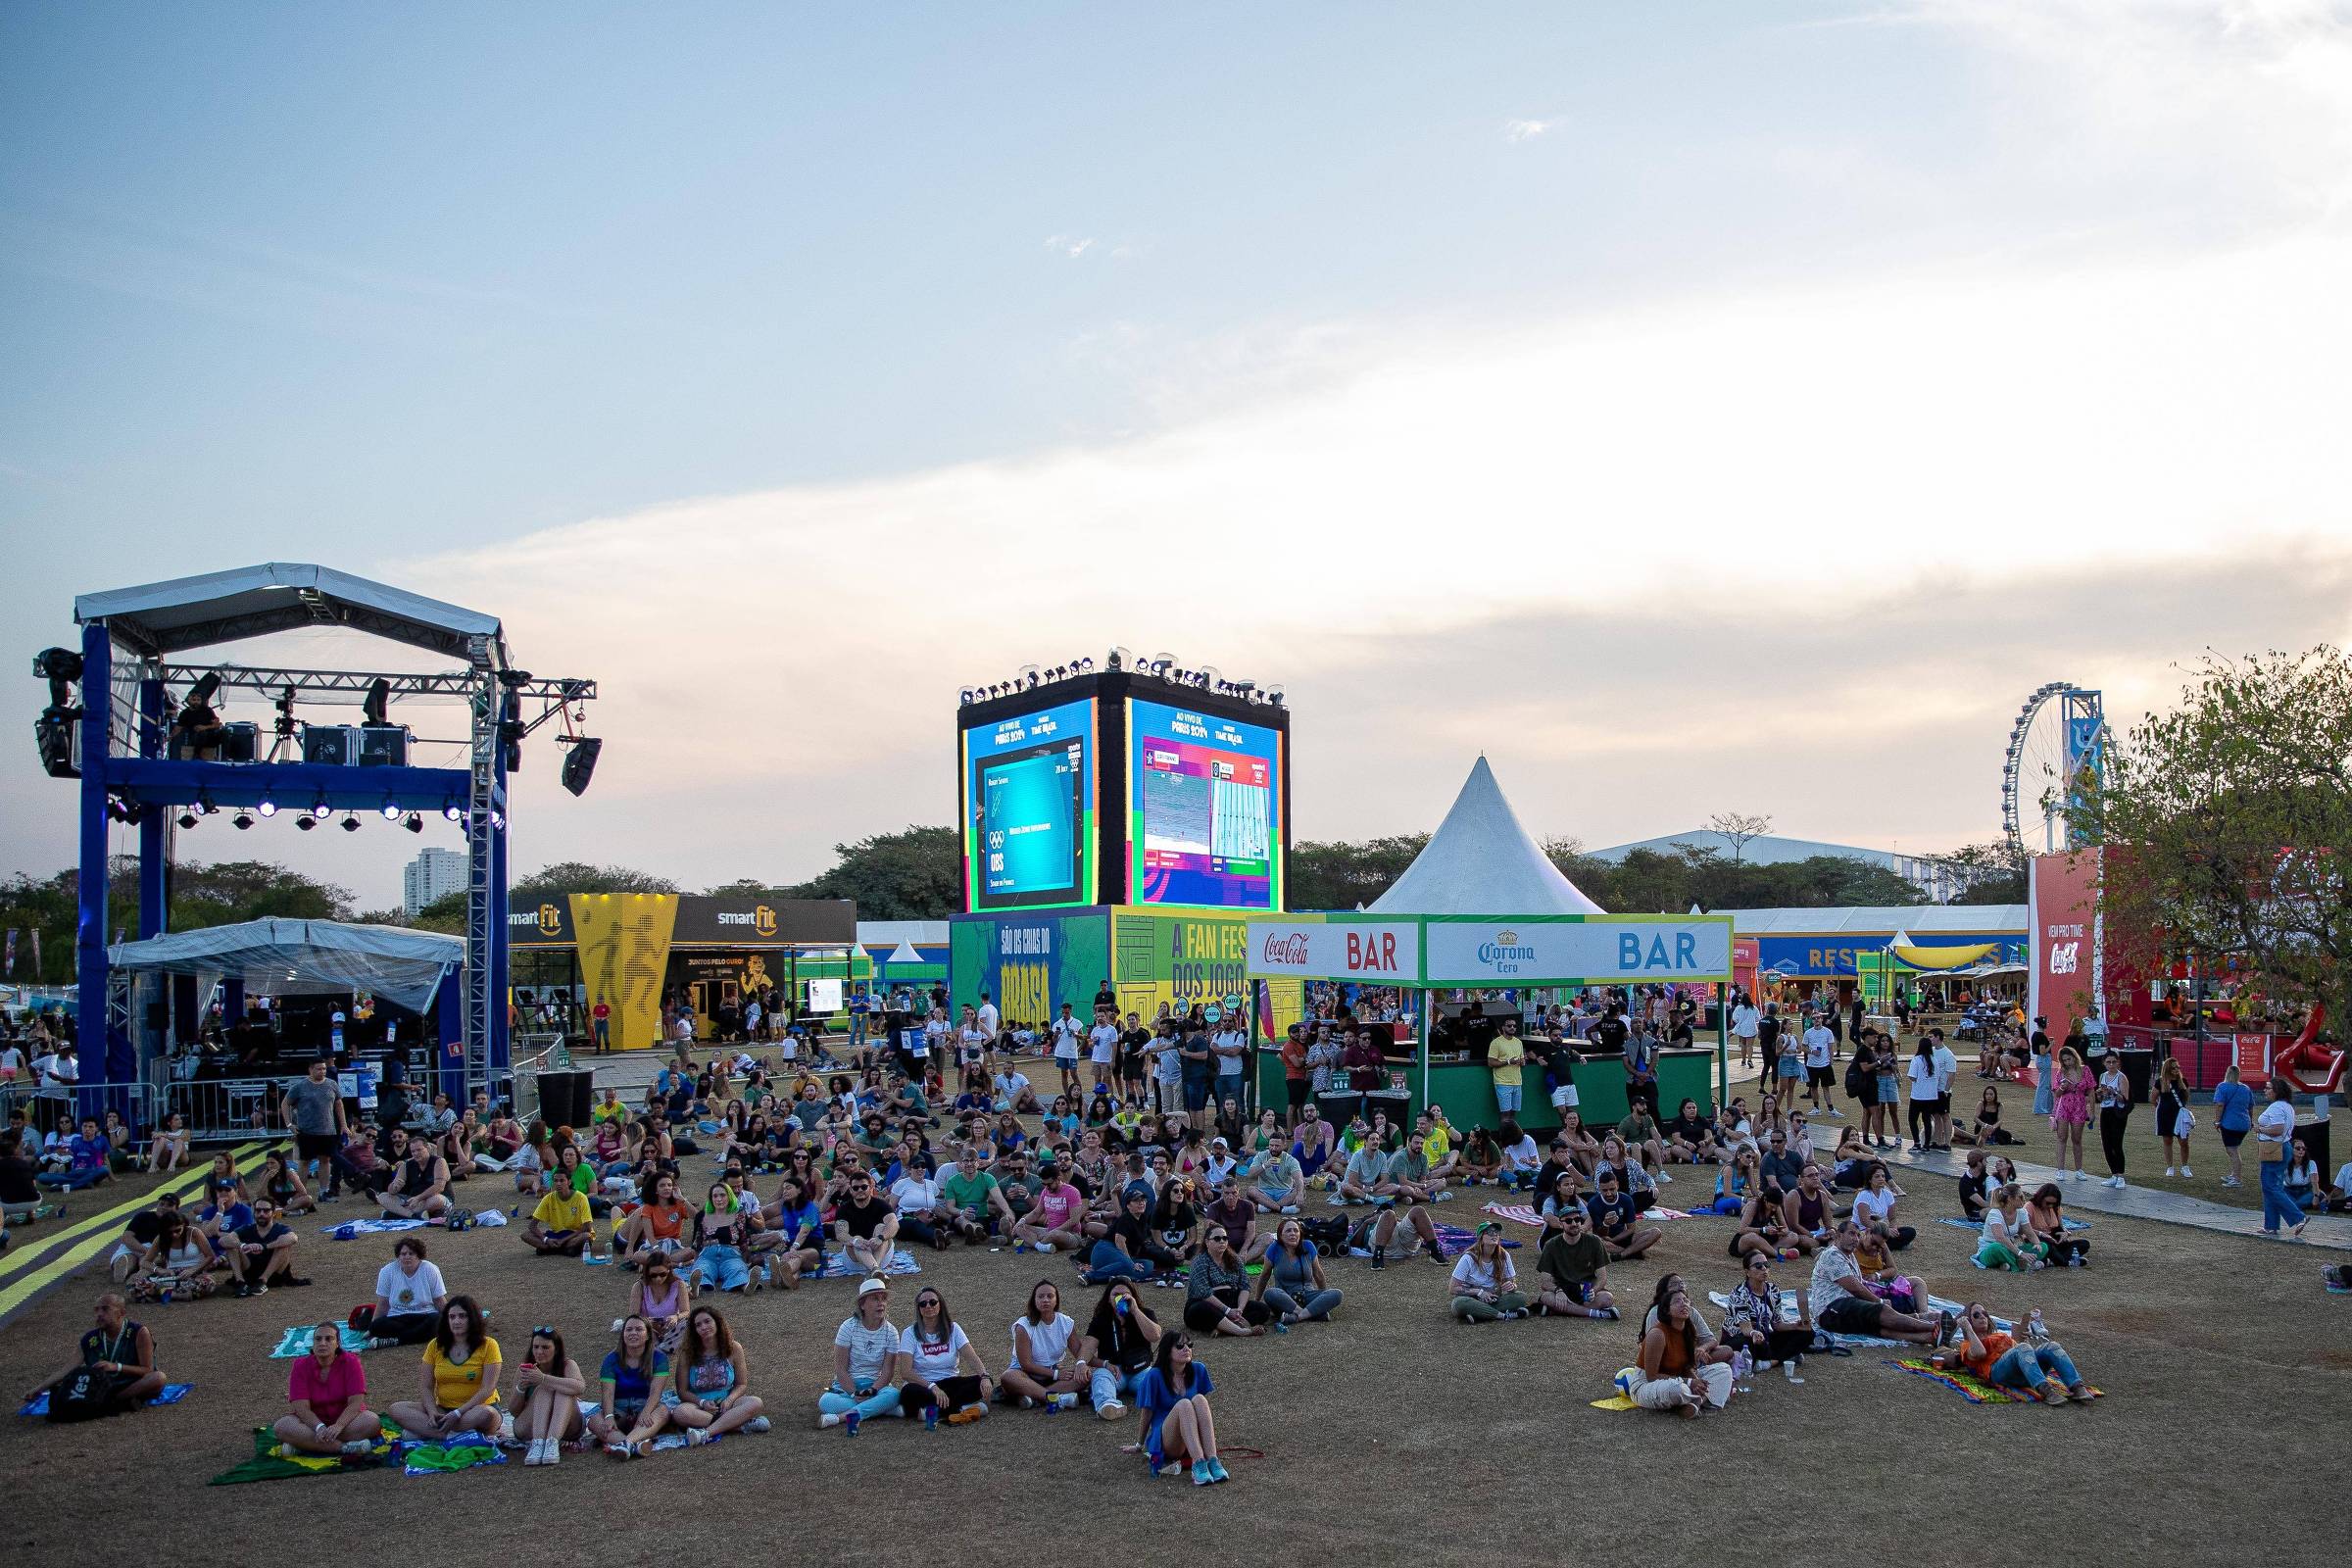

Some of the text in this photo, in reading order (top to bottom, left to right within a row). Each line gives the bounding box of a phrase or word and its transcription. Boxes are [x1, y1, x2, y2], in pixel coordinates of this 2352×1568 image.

[991, 853, 1004, 872] OBS
[540, 904, 561, 927] fit
[756, 906, 777, 928] fit
[1002, 926, 1051, 955] SÃO OS CRIAS DO
[1172, 923, 1183, 957] A
[1187, 924, 1215, 958] FAN
[2048, 924, 2083, 937] VEM PRO TIME
[1264, 933, 1397, 971] Coca-Cola BAR
[1478, 942, 1537, 965] Corona
[1619, 932, 1697, 970] BAR
[1497, 961, 1518, 973] Cero
[1172, 962, 1203, 998] DOS
[69, 1375, 90, 1399] Yes
